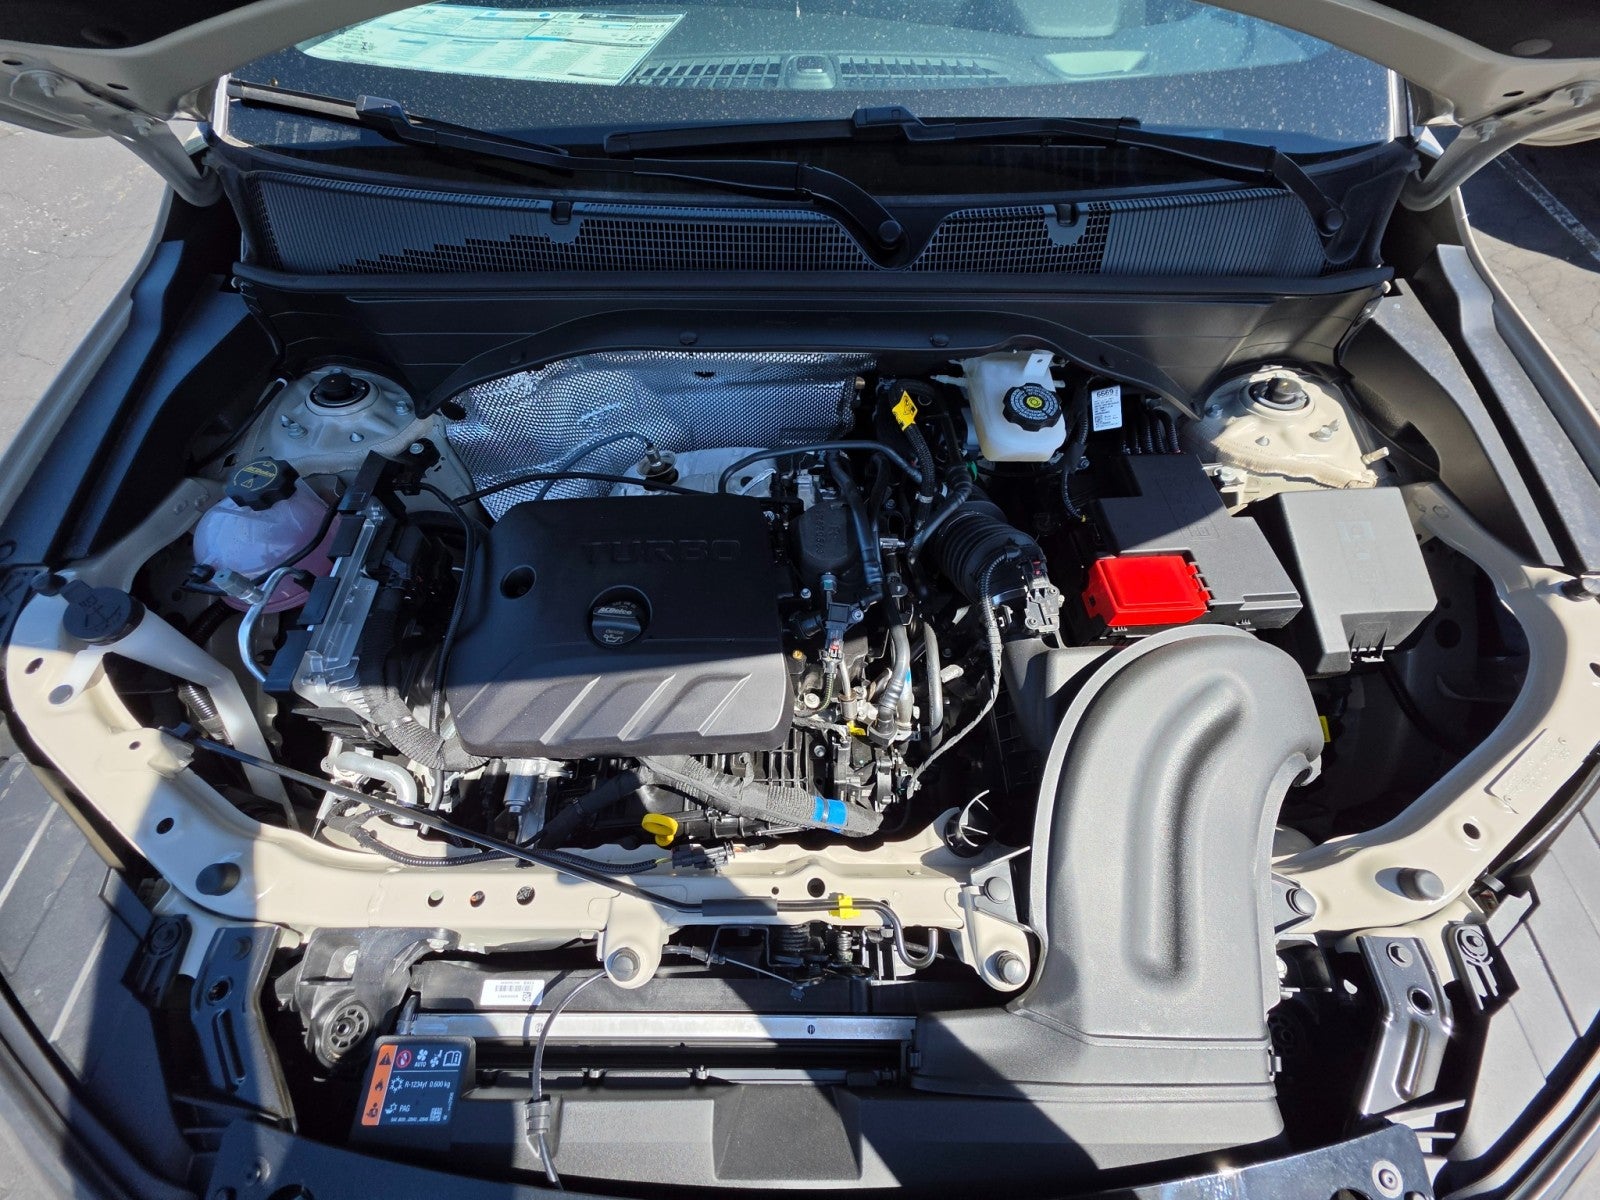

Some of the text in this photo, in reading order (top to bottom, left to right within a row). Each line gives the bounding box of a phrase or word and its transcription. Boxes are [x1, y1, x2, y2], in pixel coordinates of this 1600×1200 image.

[586, 539, 741, 562] TURBO
[597, 607, 632, 615] ACDelco
[404, 1080, 428, 1089] R-1234yf
[443, 1080, 451, 1088] kg
[399, 1104, 411, 1112] PAG
